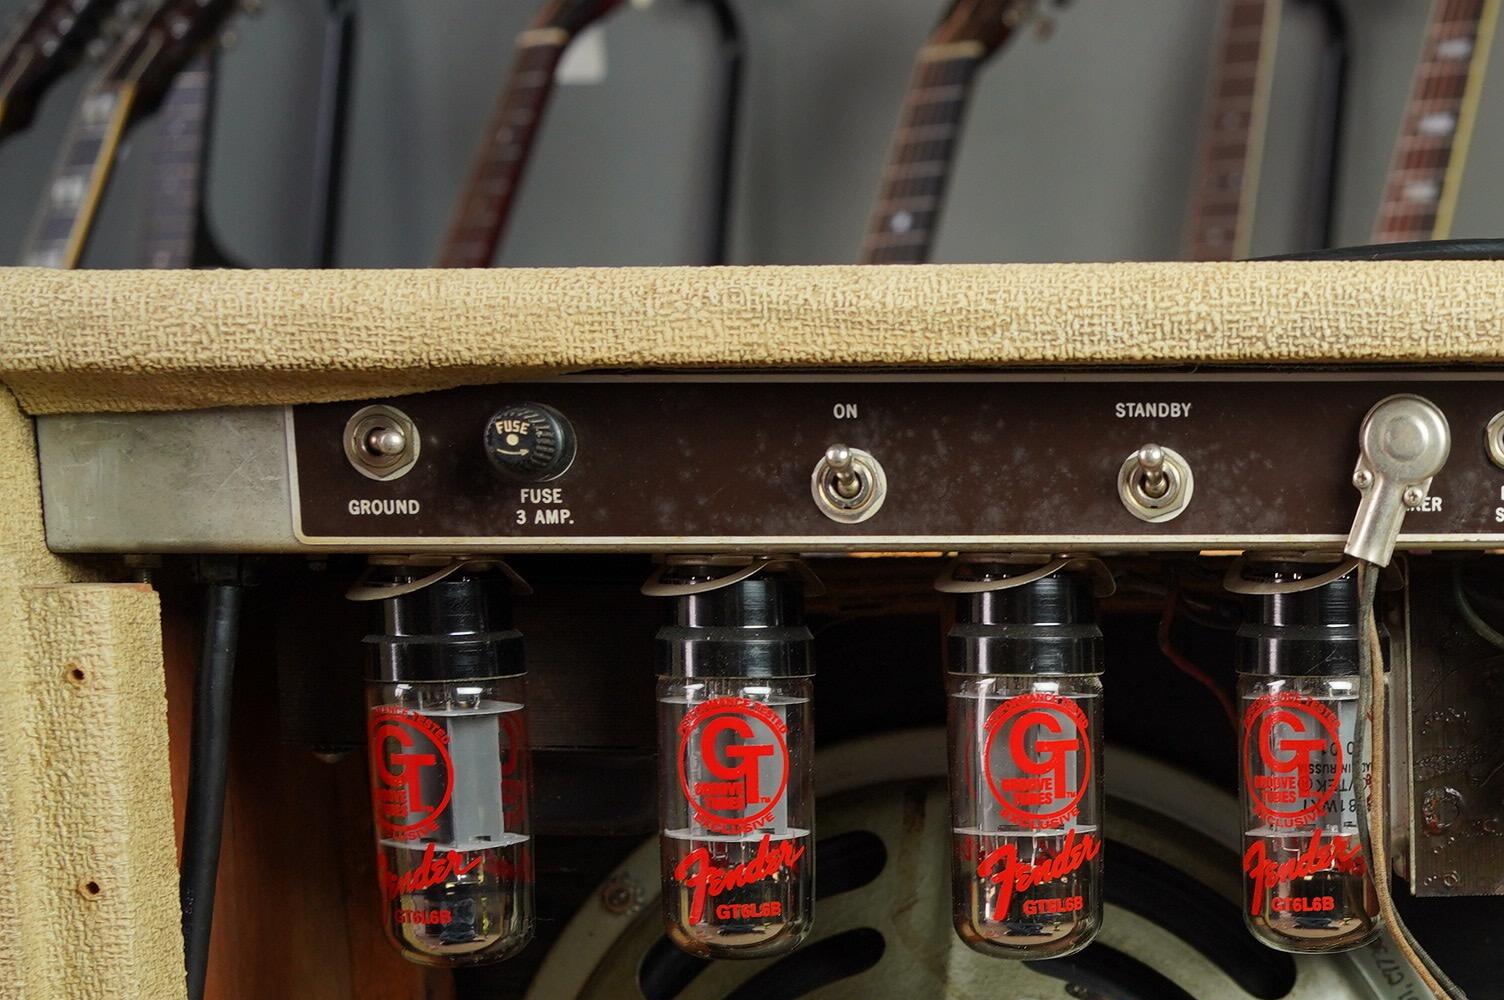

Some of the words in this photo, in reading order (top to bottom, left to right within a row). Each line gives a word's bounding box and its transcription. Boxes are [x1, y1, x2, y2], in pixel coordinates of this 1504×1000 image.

[494, 419, 530, 436] FUSE
[833, 403, 859, 419] ON
[1115, 402, 1191, 418] STANDBY
[348, 498, 420, 516] GROUND
[516, 510, 527, 524] 3
[535, 509, 574, 524] AMP.
[520, 488, 563, 504] FUSE
[375, 724, 438, 813] GT
[700, 716, 775, 805] GT
[1008, 711, 1079, 799] GT
[1258, 710, 1327, 799] GT
[674, 833, 806, 927] Fender
[977, 828, 1102, 922] Fender
[1244, 827, 1362, 917] Fender
[1271, 895, 1335, 912] GT6L6B
